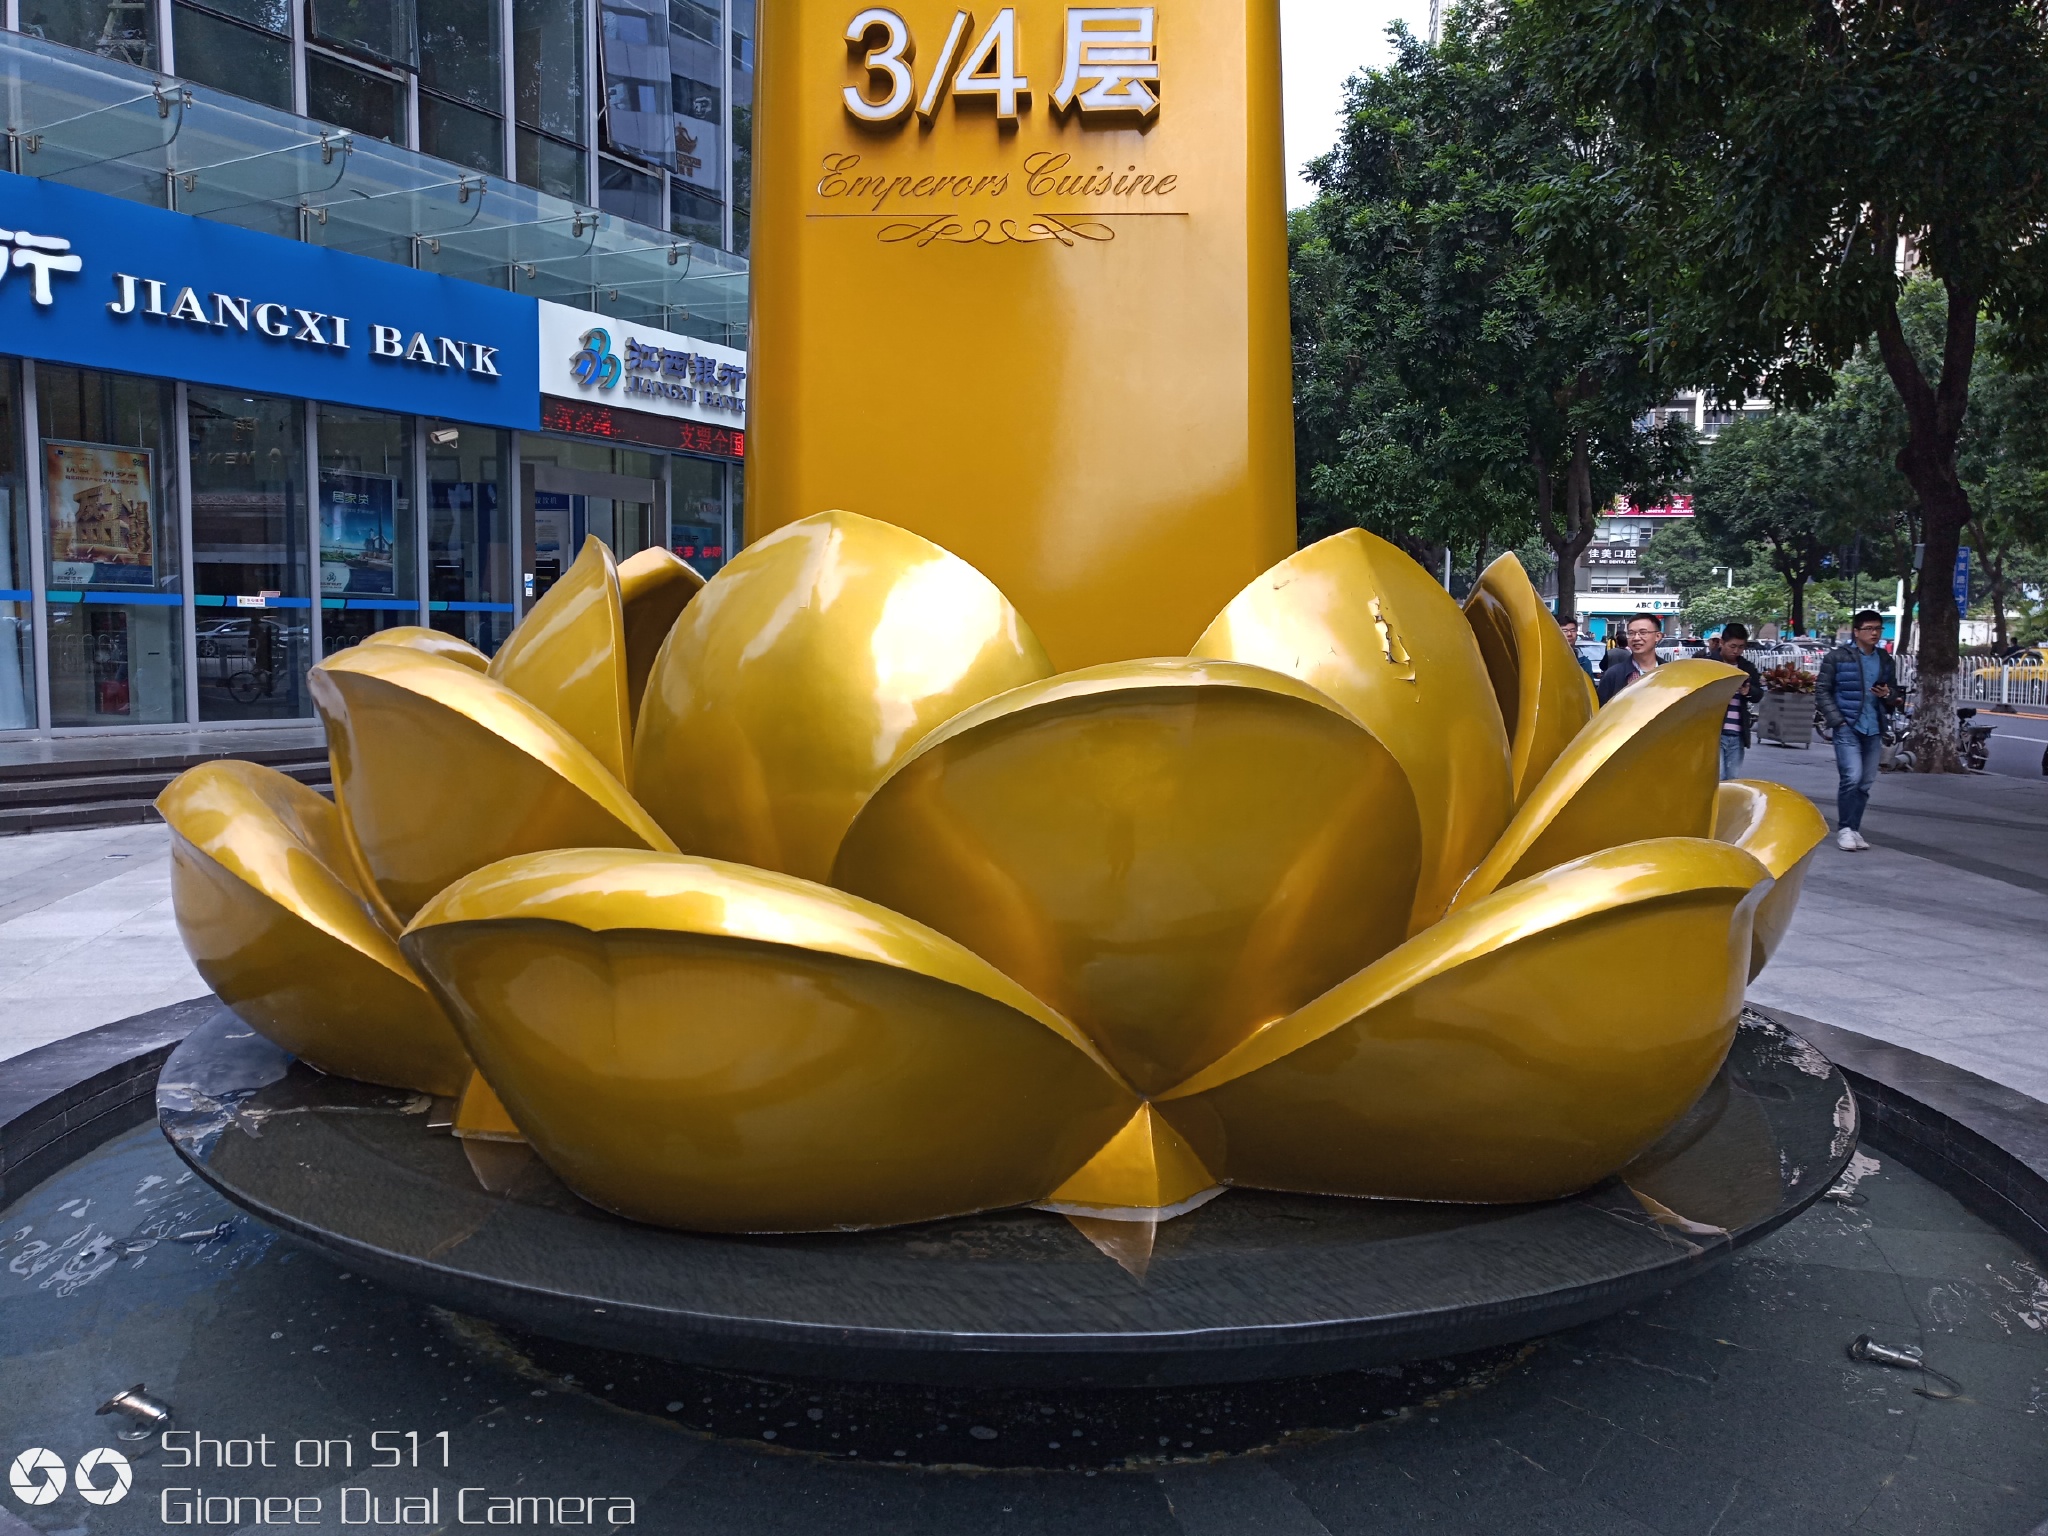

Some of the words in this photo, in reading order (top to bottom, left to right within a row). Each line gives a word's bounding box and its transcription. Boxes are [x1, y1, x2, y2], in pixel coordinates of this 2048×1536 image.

[817, 153, 1011, 212] Emperors
[1022, 151, 1178, 198] Cuisine
[105, 272, 351, 349] JIANGXI
[368, 323, 503, 377] BANK
[624, 337, 746, 393] 江西银行
[623, 375, 696, 402] JIANGXI
[699, 390, 745, 413] BANK
[1588, 548, 1637, 559] 佳美口腔
[1635, 601, 1652, 609] ABC
